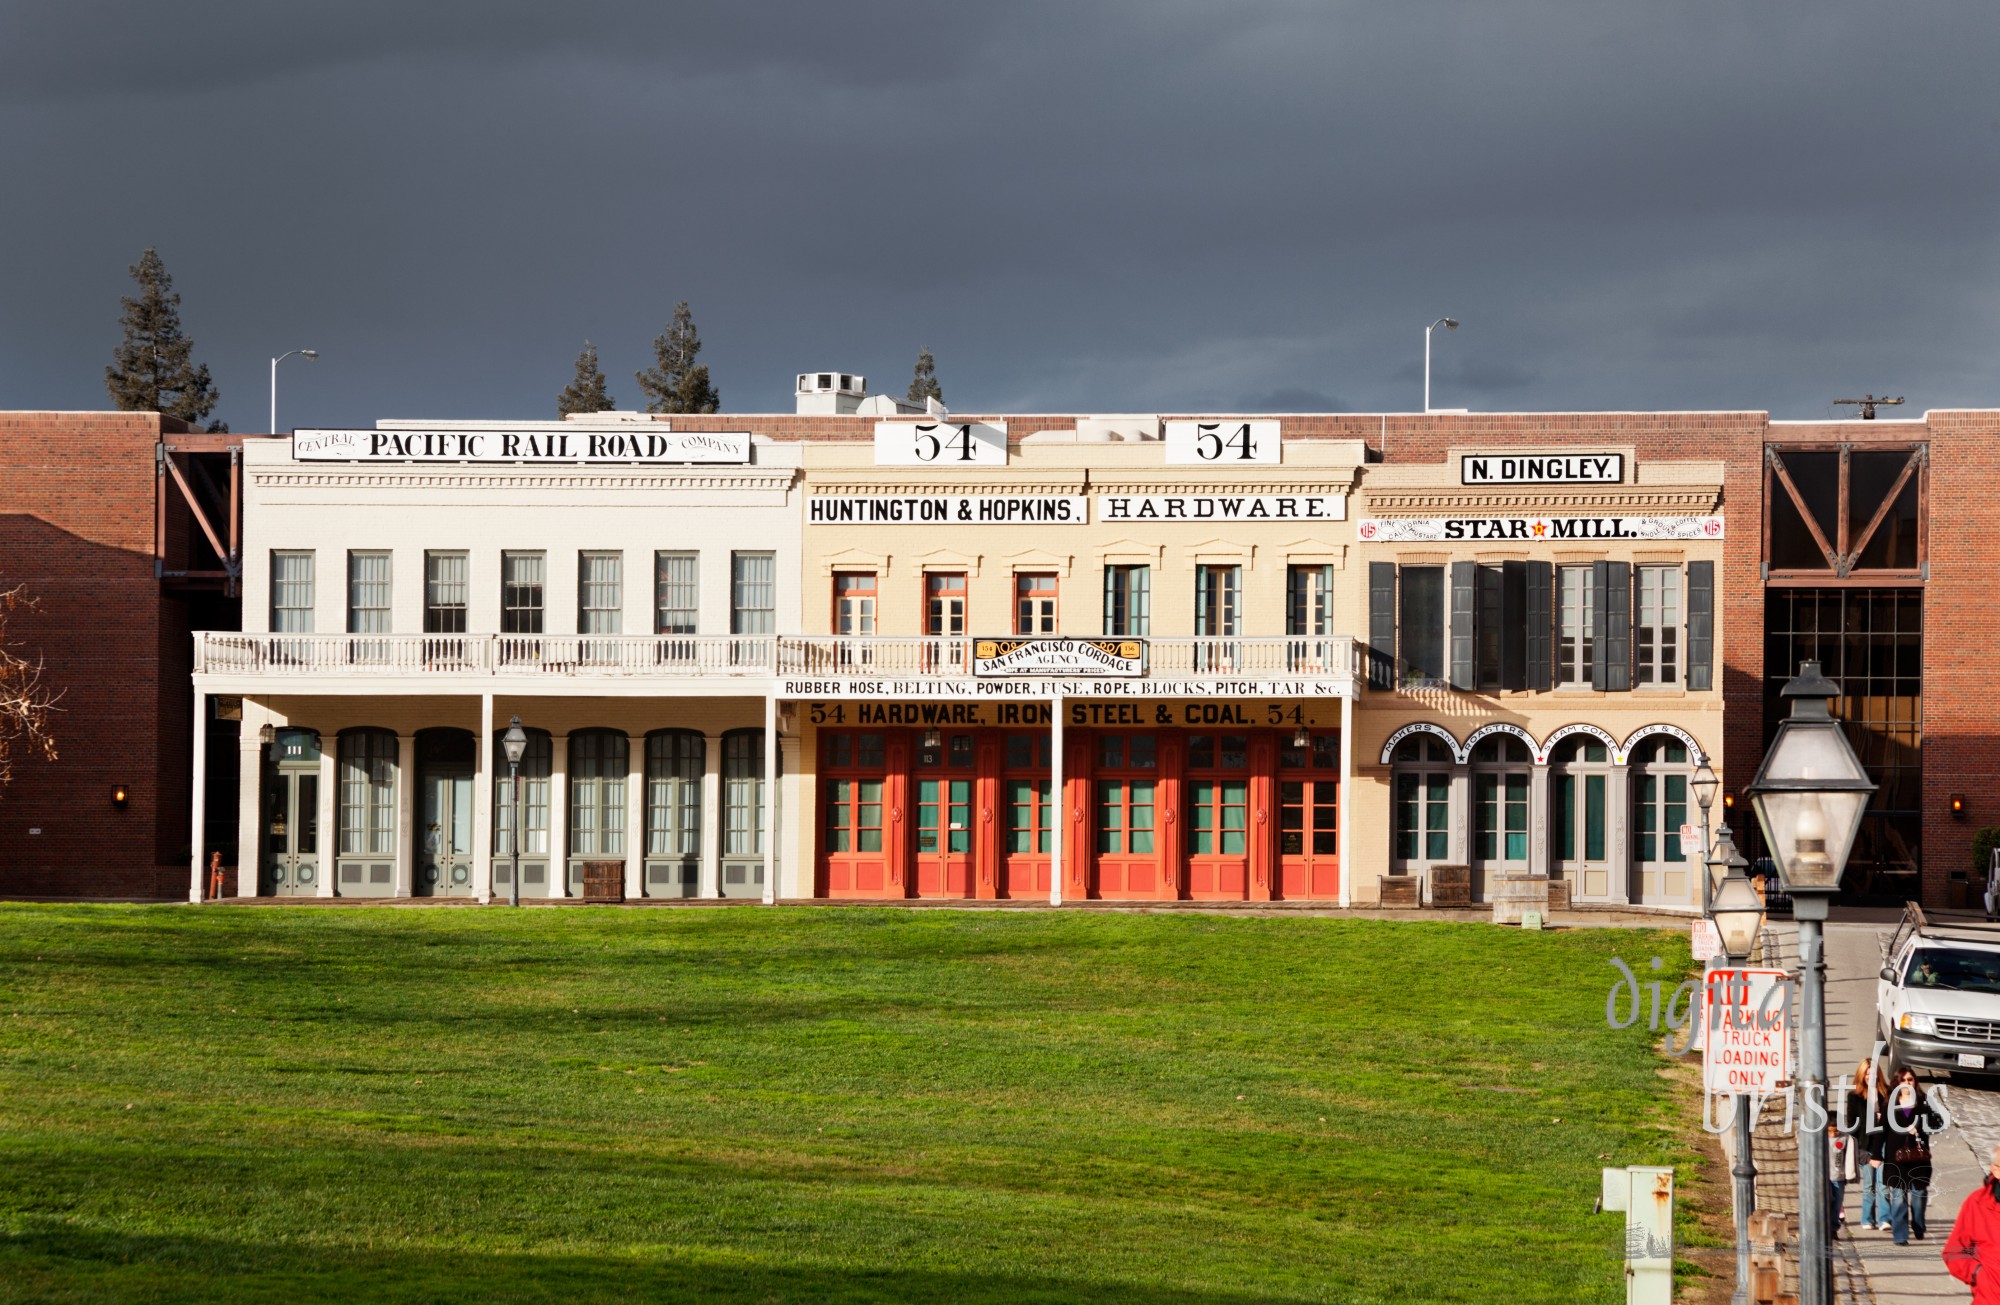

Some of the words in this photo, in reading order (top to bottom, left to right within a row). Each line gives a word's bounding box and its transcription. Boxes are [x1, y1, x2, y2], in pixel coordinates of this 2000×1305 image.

[298, 433, 355, 452] CENTRAL
[368, 433, 485, 457] PACIFIC
[501, 434, 577, 457] RAIL
[587, 434, 668, 457] ROAD
[681, 435, 742, 455] COMPANY
[914, 424, 976, 461] 54
[1196, 423, 1257, 460] 54
[1472, 459, 1493, 479] N.
[1502, 458, 1612, 479] DINGLEY.
[811, 499, 947, 521] HUNTINGTON
[957, 499, 973, 521] &
[979, 499, 1080, 522] HOPKINS,
[1108, 498, 1331, 518] HARDWARE.
[1380, 520, 1395, 528] FINE
[1388, 520, 1430, 540] CALIFORNIA
[1445, 519, 1529, 539] STAR
[1551, 518, 1637, 538] MILL.
[1648, 518, 1676, 536] GROUND
[1675, 517, 1697, 527] COFFEE
[1640, 528, 1660, 538] WHOLE
[1677, 527, 1701, 538] SPICES
[983, 657, 1006, 672] SAN
[1007, 641, 1074, 666] FRANCISCO
[1078, 643, 1133, 672] CORDAGE
[1035, 655, 1081, 664] AGENCY
[785, 682, 841, 694] RUBBER
[849, 682, 889, 695] HOSE,
[893, 682, 972, 695] BELTING,
[976, 682, 1036, 695] POWDER,
[1041, 682, 1089, 695] FUSE,
[1094, 682, 1136, 695] ROPE,
[1141, 682, 1212, 695] BLOCKS,
[1216, 682, 1263, 695] PITCH,
[1268, 682, 1305, 694] TAR
[810, 703, 846, 724] 54
[858, 703, 986, 726] HARDWARE,
[998, 703, 1053, 724] IRON
[1072, 703, 1145, 724] STEEL
[1155, 703, 1173, 724] &
[1185, 703, 1256, 724] COAL.
[1385, 724, 1432, 753] MAKERS
[1436, 730, 1457, 749] AND
[1465, 724, 1525, 750] ROASTERS
[1527, 739, 1538, 751] OF
[1544, 726, 1577, 751] STEAM
[1581, 726, 1618, 751] COFFEE
[1623, 726, 1656, 752] SPICES
[1673, 728, 1699, 755] SYRUP
[1695, 923, 1706, 933] NO
[1723, 1031, 1771, 1046] TRUCK
[1715, 1049, 1779, 1066] LOADING
[1729, 1070, 1766, 1085] ONLY
